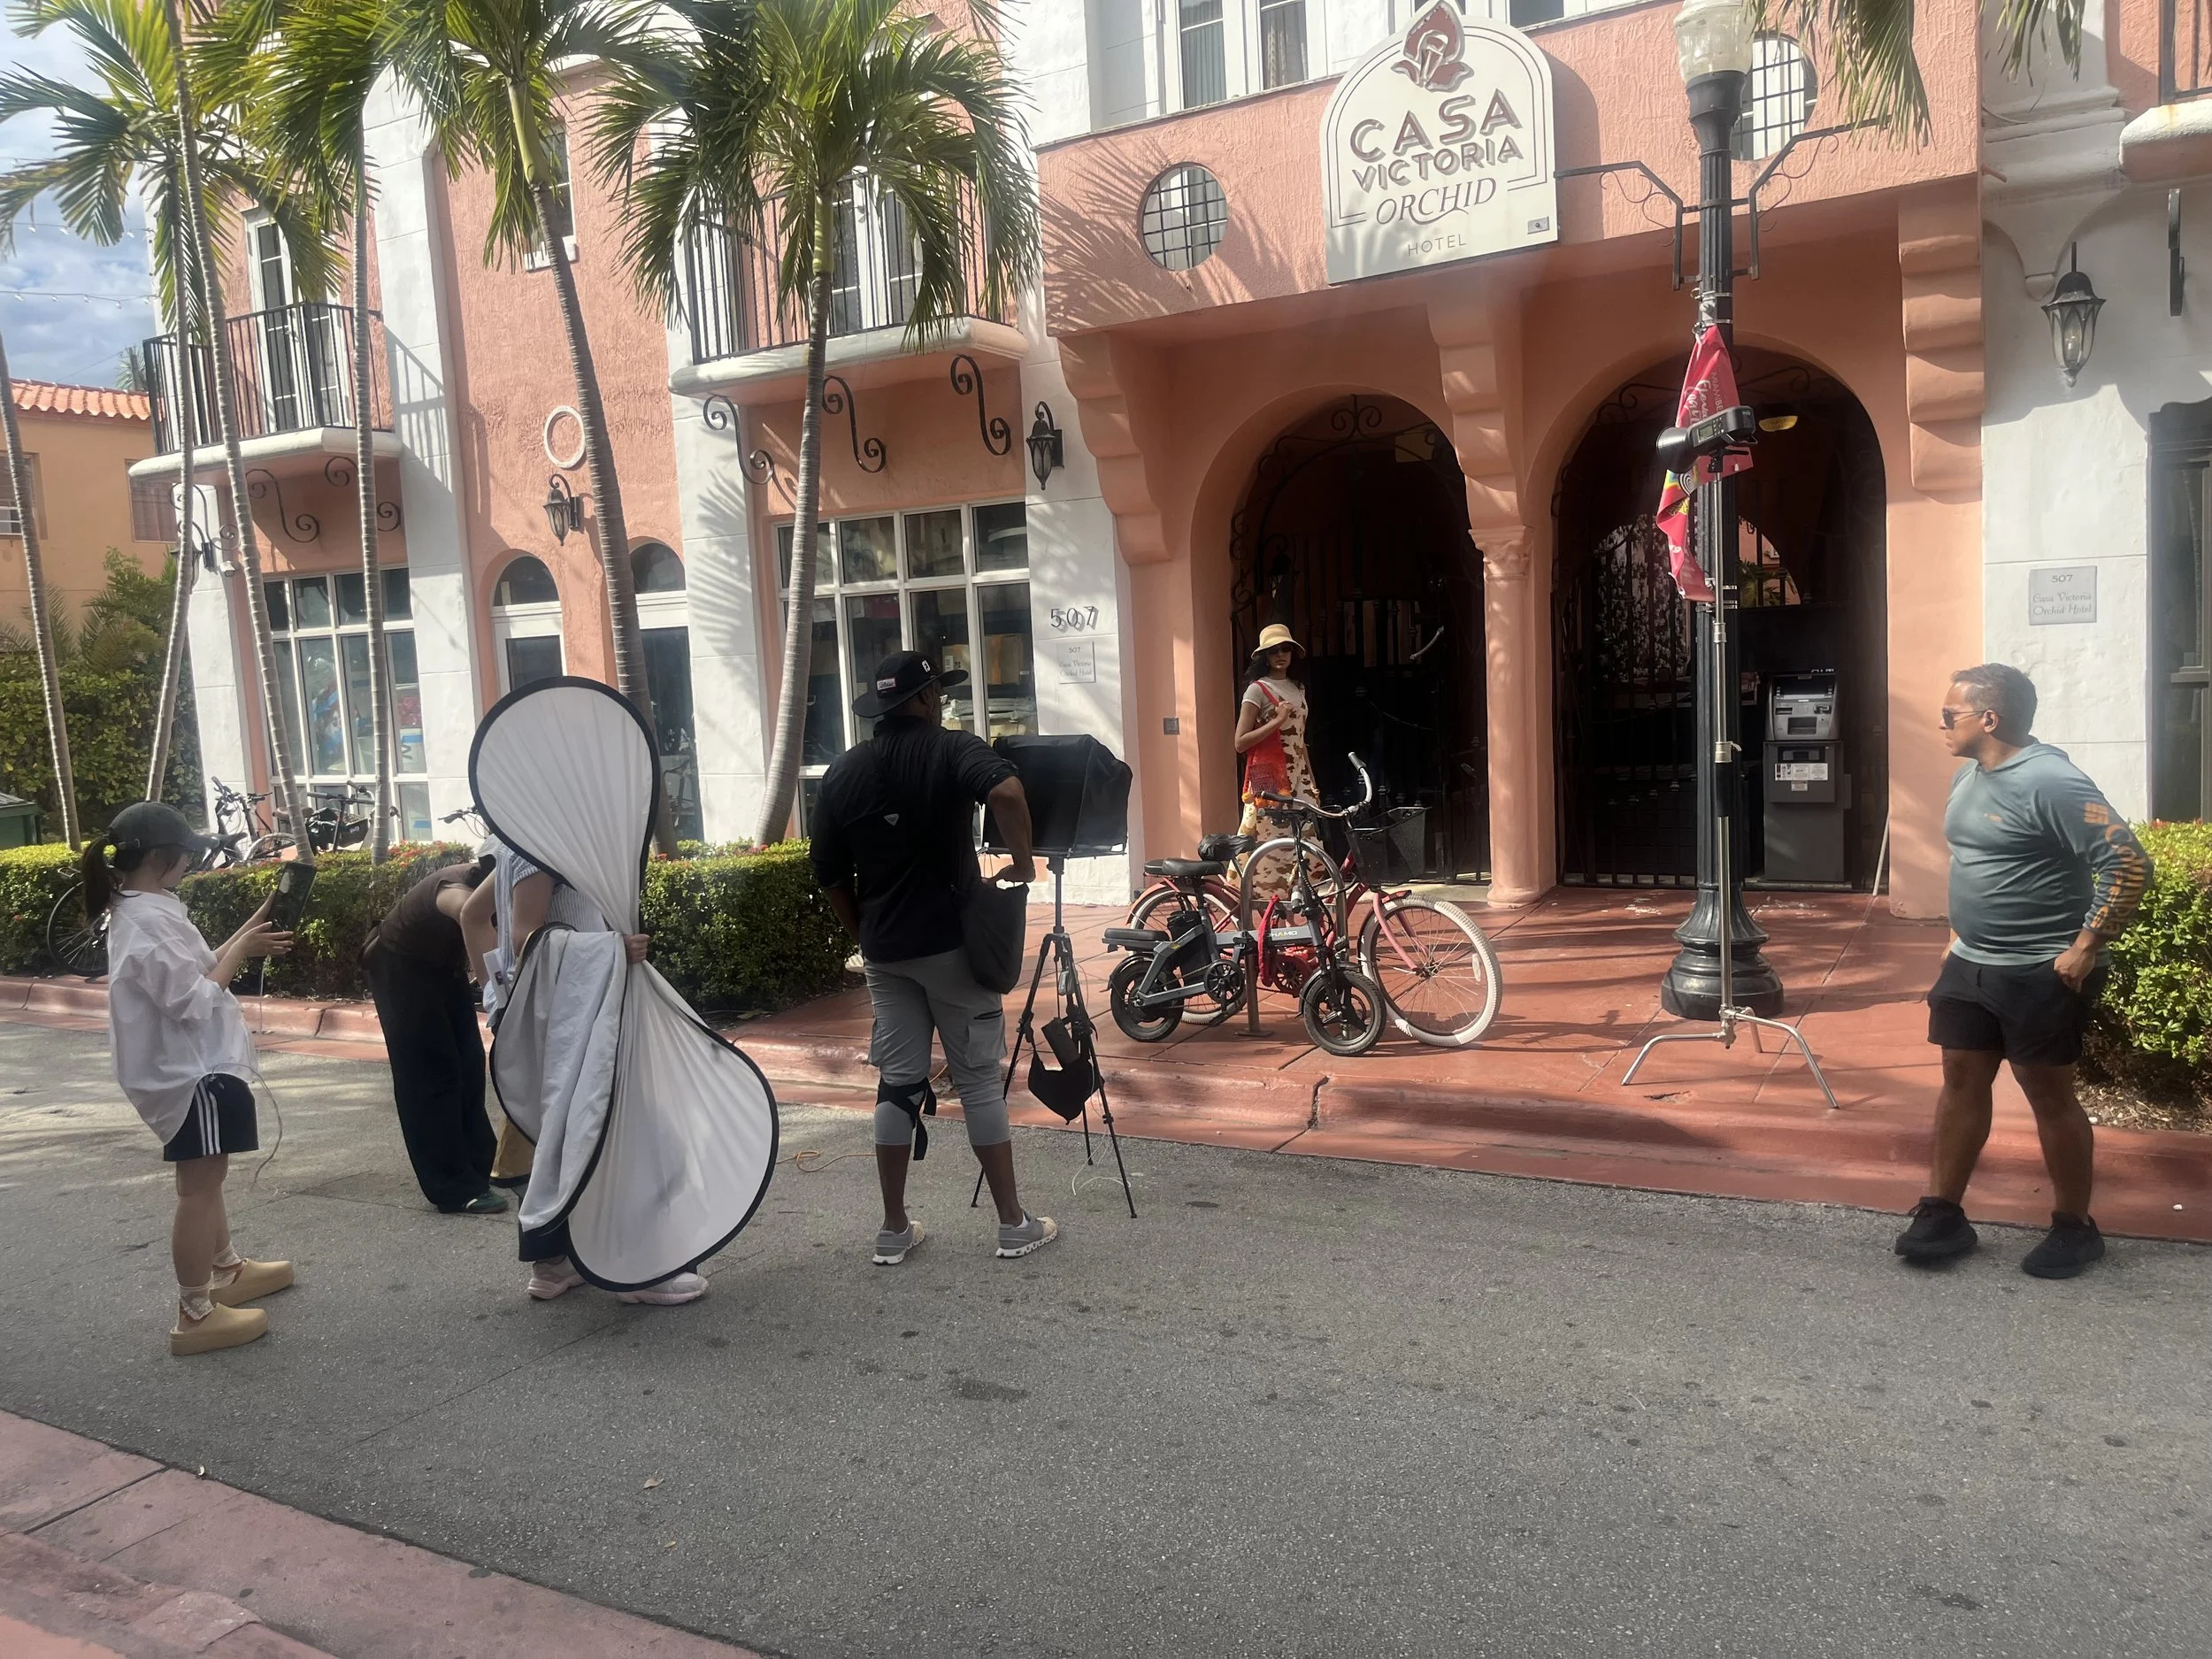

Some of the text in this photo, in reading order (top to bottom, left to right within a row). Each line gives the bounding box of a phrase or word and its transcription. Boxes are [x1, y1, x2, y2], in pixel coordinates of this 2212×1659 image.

[1349, 88, 1523, 163] CASA
[1351, 134, 1524, 194] VICTORIA
[1376, 177, 1497, 225] ORCHID
[1408, 234, 1467, 257] HOTEL
[1711, 372, 1724, 411] MIAMIBE
[2052, 574, 2074, 583] 507
[2032, 592, 2092, 603] Casa Victoria
[1050, 606, 1096, 629] 507
[2032, 603, 2092, 616] Orchid Hotel
